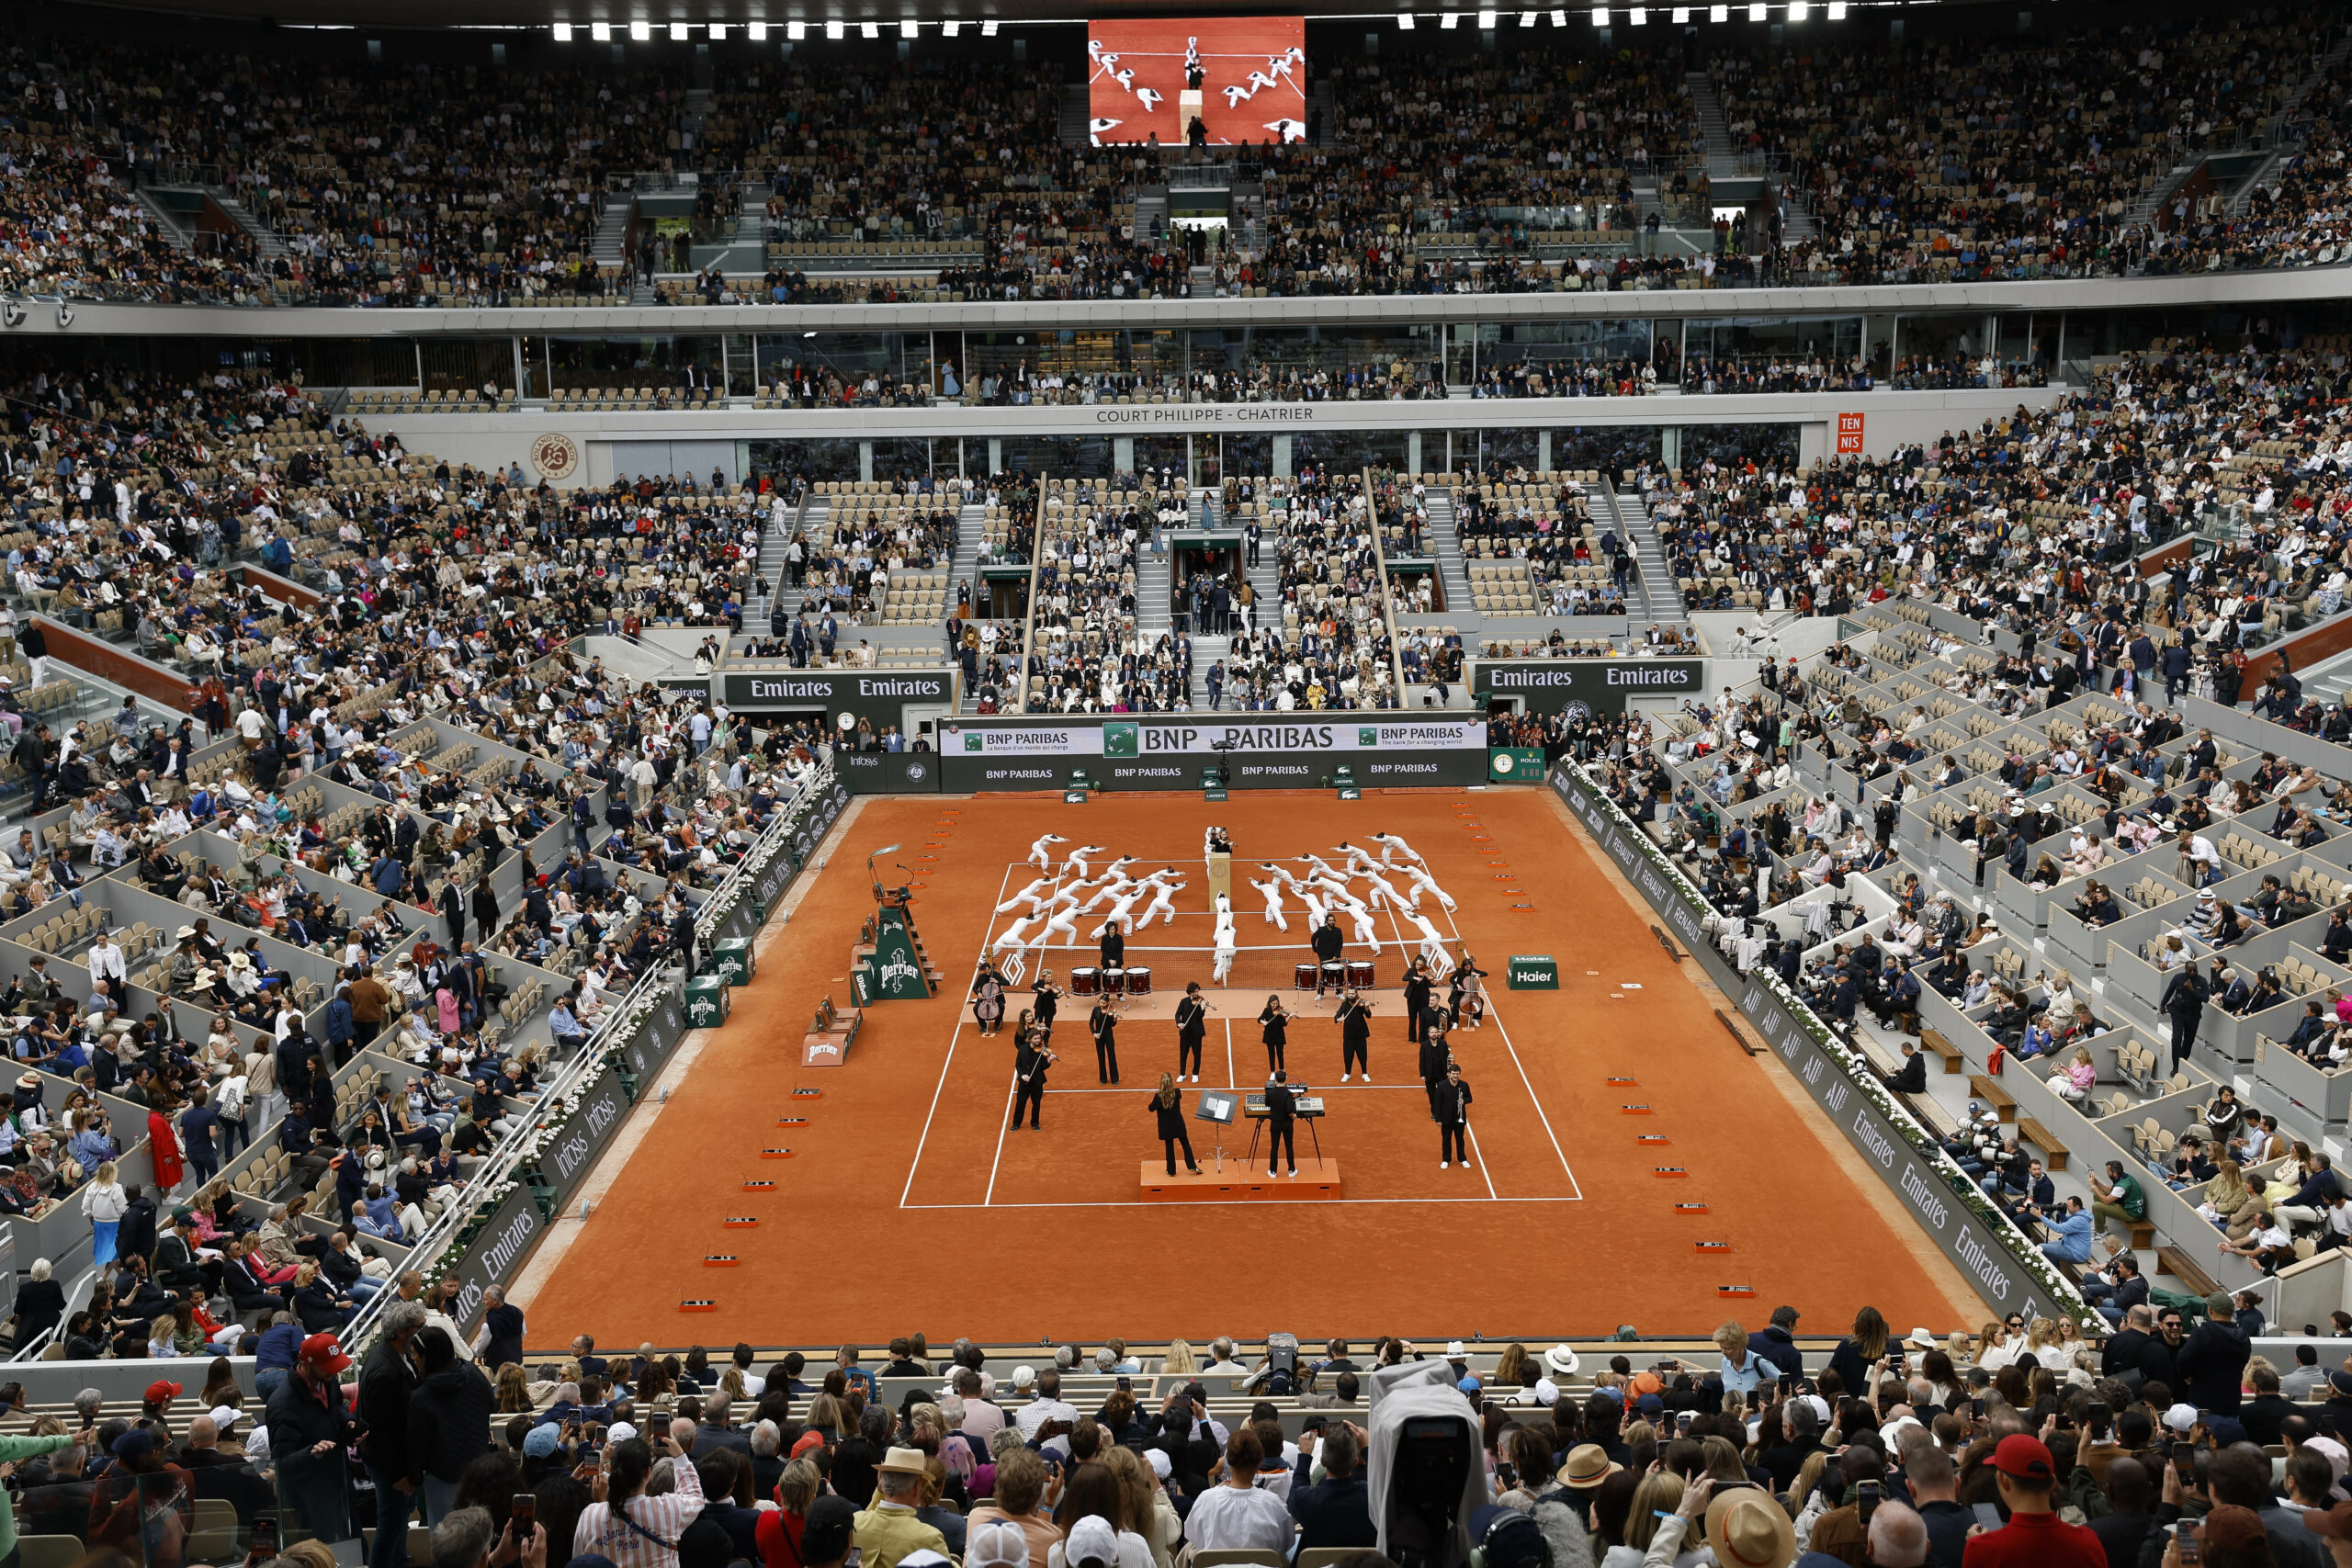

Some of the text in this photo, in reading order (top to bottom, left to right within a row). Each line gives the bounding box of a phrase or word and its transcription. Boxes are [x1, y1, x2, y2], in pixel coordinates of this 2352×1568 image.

[1097, 410, 1149, 422] COURT
[1155, 409, 1222, 421] PHILIPPE
[1237, 408, 1312, 420] CHATRIER
[1841, 418, 1860, 429] TEN
[533, 435, 575, 462] ROLAND GARROS
[1841, 437, 1859, 448] NIS
[1491, 668, 1572, 686] Emirates
[1607, 667, 1688, 685] Emirates
[671, 688, 707, 697] mirates
[751, 680, 832, 697] Emirates
[859, 678, 940, 696] Emirates
[987, 733, 1068, 745] BNP PARIBAS
[1145, 727, 1333, 750] BNP PARIBAS
[1381, 727, 1463, 739] BNP PARIBAS
[850, 756, 878, 767] Infosys
[1242, 765, 1309, 775] BNP PARIBAS
[1371, 764, 1437, 773] BNP PARIBAS
[987, 769, 1052, 779] BNP PARIBAS
[1115, 767, 1181, 777] BNP PARIBAS
[1612, 837, 1635, 866] RENAULT
[1641, 869, 1666, 902] RENAULT
[1674, 906, 1702, 943] RENAULT
[881, 963, 918, 989] perrier
[1517, 971, 1552, 982] Haier
[855, 974, 868, 1001] Wilson
[808, 1044, 837, 1063] perrier
[585, 1093, 616, 1138] Infosys
[1853, 1108, 1895, 1168] Emirates
[554, 1130, 588, 1179] Infosys
[1901, 1162, 1949, 1230] Emirates
[481, 1207, 534, 1281] Emirates
[1955, 1224, 2010, 1301] Emirates
[456, 1278, 482, 1323] ates
[616, 1539, 640, 1551] Paris
